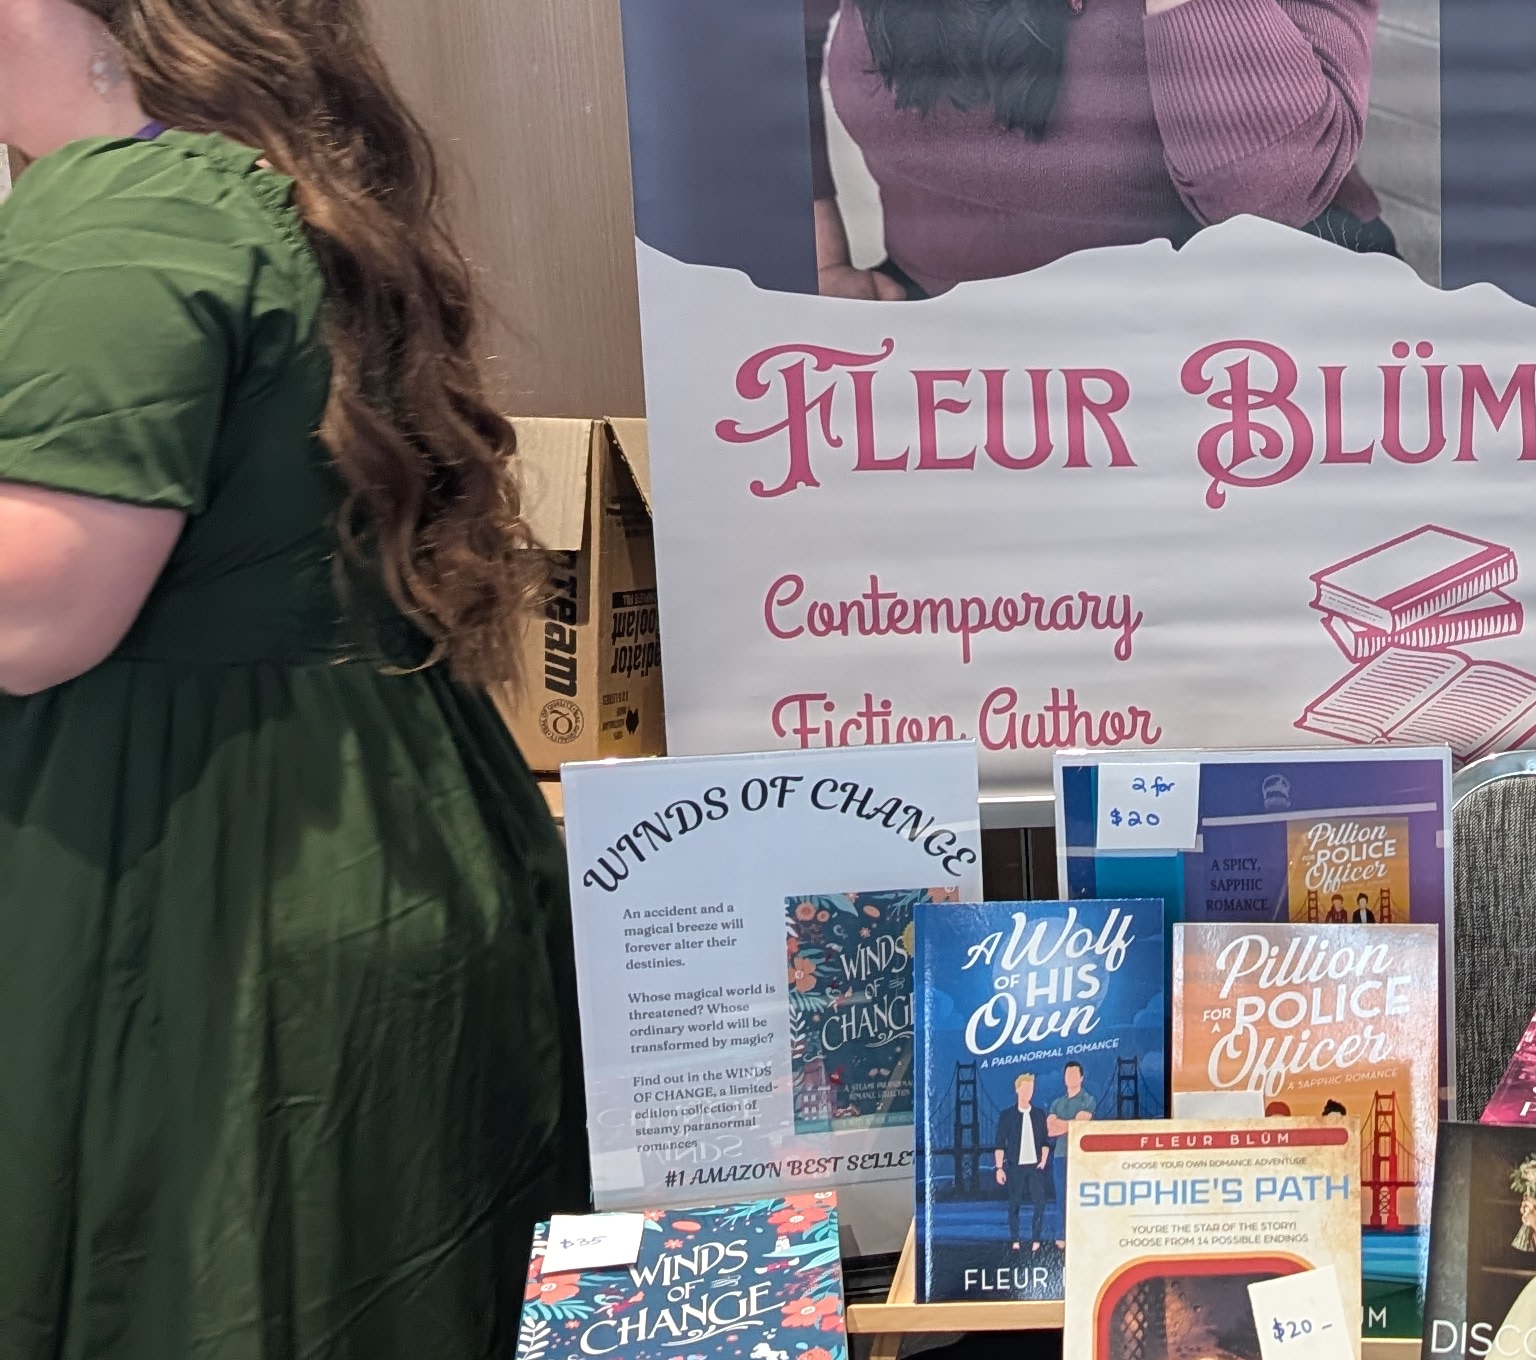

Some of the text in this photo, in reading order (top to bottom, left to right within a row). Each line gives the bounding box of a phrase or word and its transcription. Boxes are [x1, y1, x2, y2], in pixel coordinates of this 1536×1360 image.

[715, 338, 1138, 498] FLEUR
[611, 608, 660, 645] oolant
[764, 575, 1144, 663] Contemporary
[611, 641, 661, 678] adiator
[772, 686, 1161, 751] Fiction Author
[1132, 776, 1175, 797] 2 for
[1110, 808, 1160, 827] $20
[583, 776, 977, 892] WINDS OF CHANGE
[1308, 822, 1387, 851] Pillion
[1316, 839, 1396, 865] POLICE
[1211, 858, 1261, 872] A SPICY,
[1210, 878, 1263, 891] SAPPHIC
[1305, 860, 1388, 894] Officer
[623, 903, 734, 920] An accident and a
[1206, 899, 1268, 911] ROMANCE
[624, 919, 744, 937] magical breeze will
[961, 907, 1135, 972] A Wolf
[625, 936, 737, 953] forever alter their
[625, 957, 686, 970] destinies.
[840, 934, 908, 981] WINDS
[1215, 934, 1394, 999] Pillion
[628, 983, 776, 1003] Whose magical world is
[865, 977, 884, 999] OF
[994, 963, 1100, 1007] OF HIS
[629, 1003, 750, 1020] threatened? Whose
[1203, 974, 1412, 1034] FOR POLICE
[629, 1017, 767, 1037] ordinary world will be
[965, 992, 1101, 1055] Own
[631, 1032, 774, 1053] transformed by magic?
[981, 1038, 1120, 1069] A PARANORMAL ROMANCE
[1208, 1022, 1394, 1098] A Officer
[633, 1066, 772, 1087] Find out in the WINDS
[1287, 1068, 1398, 1091] A SAPPHIC ROMANCE
[633, 1082, 779, 1103] OF CHANGE, a limited-
[635, 1100, 758, 1120] edition collection of
[635, 1116, 757, 1137] steamy paranormal
[636, 1140, 698, 1153] romances
[1140, 1132, 1290, 1148] FLEUR BLÜM
[665, 1150, 915, 1188] #1 AMAZON BEST SELLE
[1121, 1156, 1307, 1170] CHOOSE YOUR OWN ROMANCE ADVENTURE
[1080, 1174, 1349, 1207] SOPHIE'S PATH
[1131, 1224, 1169, 1234] YOU'RE
[1171, 1223, 1191, 1233] THE
[1193, 1222, 1221, 1232] STAR
[1222, 1222, 1237, 1232] OF
[1238, 1221, 1258, 1231] THE
[1119, 1237, 1163, 1248] CHOOSE
[1165, 1236, 1195, 1246] FROM
[1211, 1234, 1261, 1245] POSSIBLE
[1263, 1233, 1309, 1244] ENDINGS
[627, 1240, 749, 1289] WINDS
[667, 1278, 705, 1302] OF
[964, 1267, 1048, 1291] FLEUR
[580, 1281, 787, 1355] CHANGE
